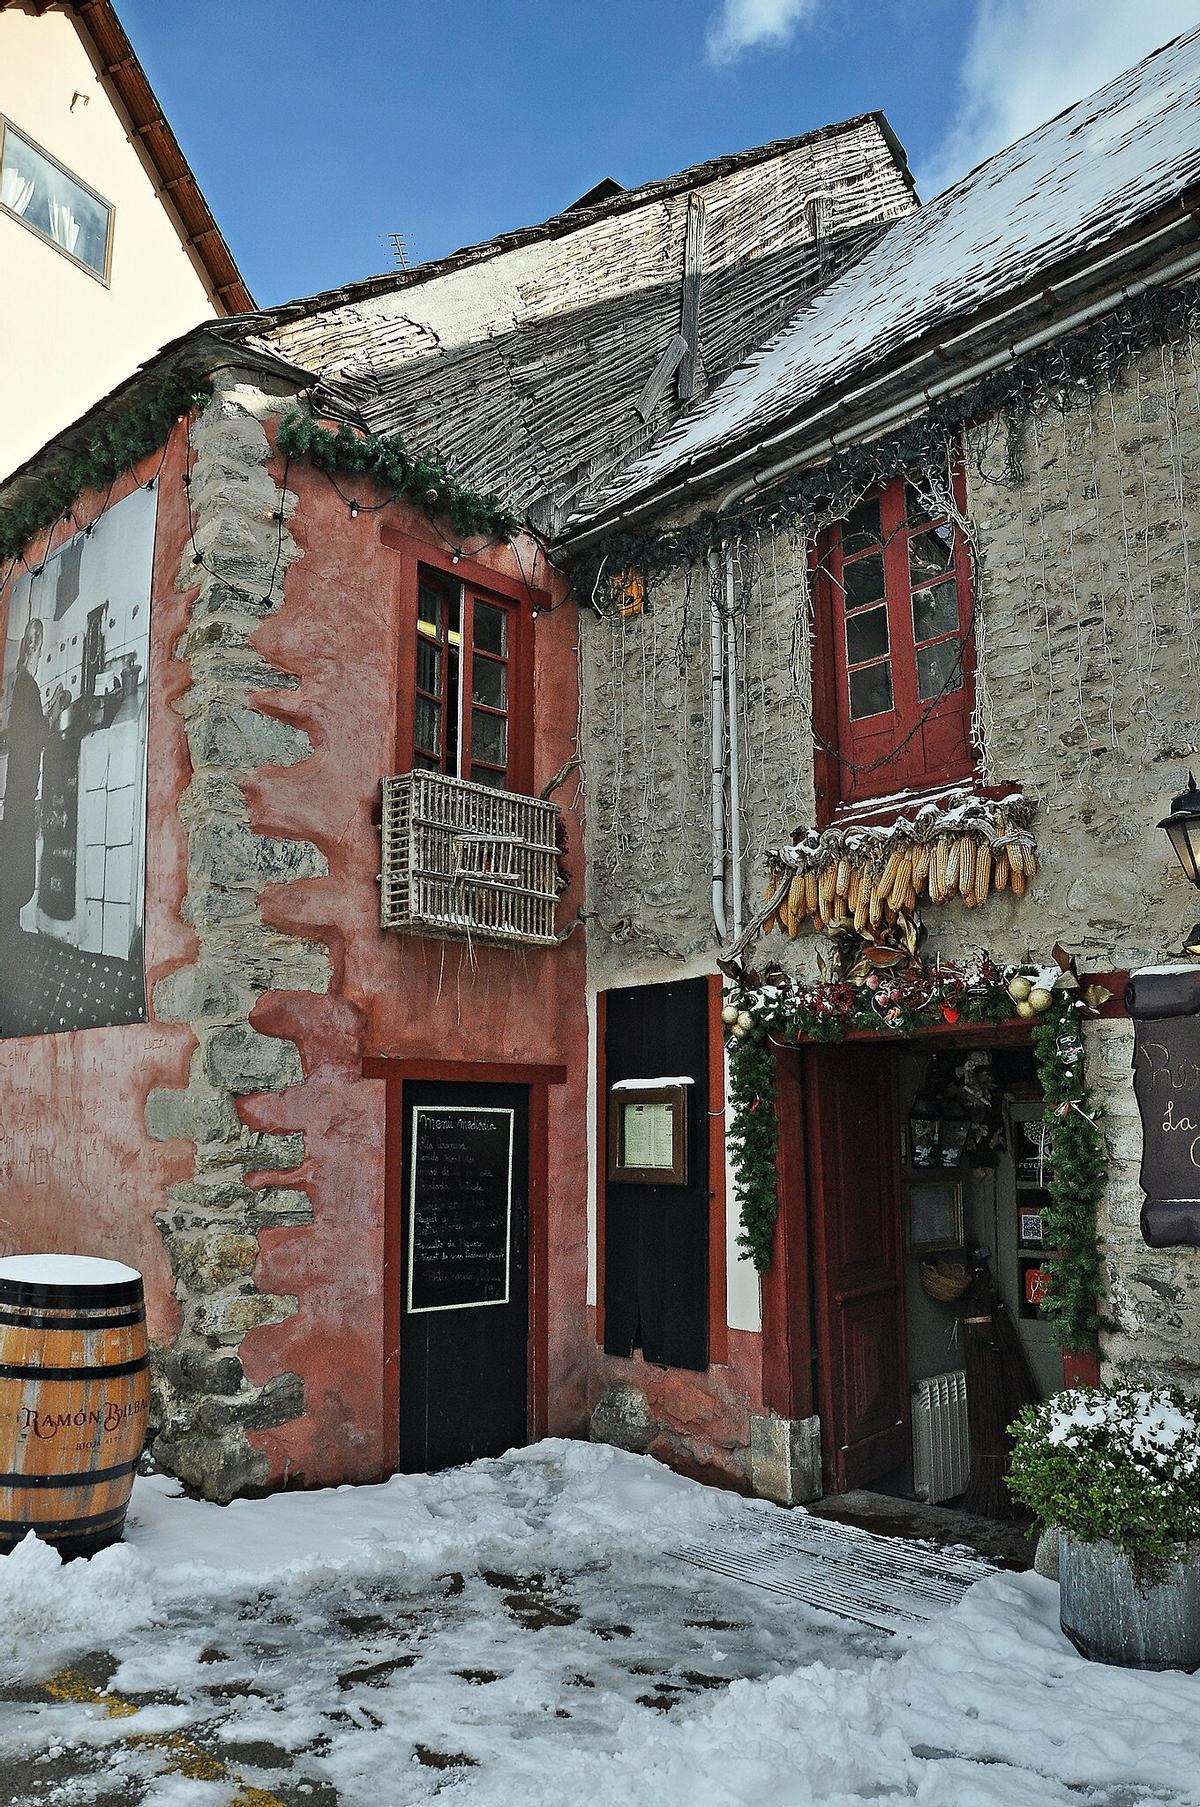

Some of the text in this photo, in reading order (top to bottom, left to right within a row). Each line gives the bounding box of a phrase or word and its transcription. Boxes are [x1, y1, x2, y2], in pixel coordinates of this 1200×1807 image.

[1162, 1099, 1197, 1132] La
[22, 1398, 149, 1439] RAMÓN BILBA
